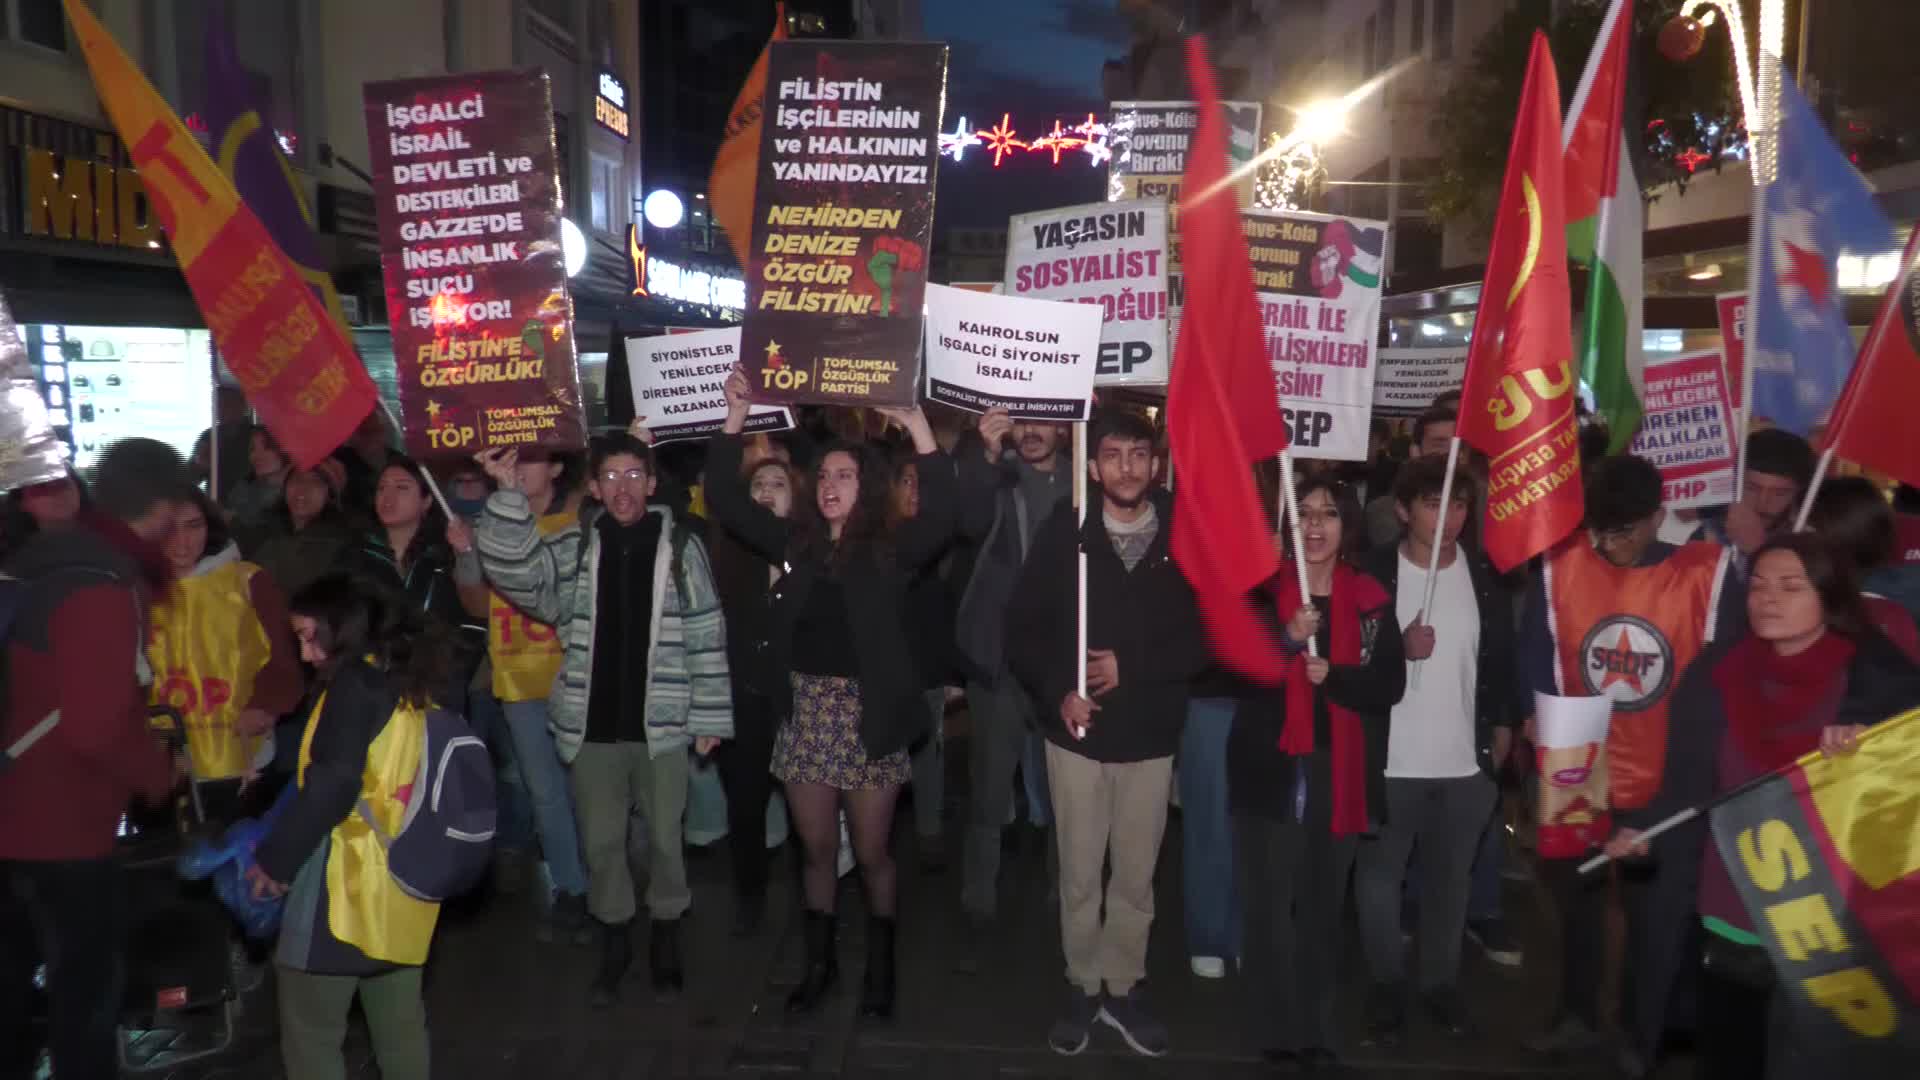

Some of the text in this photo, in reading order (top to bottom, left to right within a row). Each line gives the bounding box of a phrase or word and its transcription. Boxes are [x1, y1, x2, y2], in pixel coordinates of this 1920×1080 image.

[779, 77, 882, 101] FİLİSTİN
[386, 94, 484, 129] İŞGALCİ
[776, 104, 920, 130] İŞÇİLERİNİN
[390, 127, 472, 155] İSRAİL
[774, 135, 927, 157] ve HALKININ
[393, 152, 533, 184] DEVLETİ ve
[772, 161, 928, 184] YANINDAYIZ!
[396, 180, 520, 213] DESTEKÇİLERİ
[400, 212, 523, 241] GAZZE'DE
[767, 202, 902, 229] NEHİRDEN
[764, 231, 861, 256] DENİZE
[1033, 211, 1145, 250] YAŞASIN
[402, 241, 520, 271] İNSANLIK
[1249, 246, 1300, 265] ovunu
[763, 257, 853, 284] ÖZGÜR
[1016, 248, 1161, 293] SOSYALİST
[407, 274, 474, 299] SUÇU
[759, 286, 873, 315] FİLİSTİN!
[1317, 302, 1347, 332] İLE
[959, 321, 1060, 344] KAHROLSUN
[416, 334, 523, 364] FİLİSTİN'E
[651, 344, 734, 363] SİYONİSTLER
[939, 333, 1081, 365] İŞGALCİ SİYONİST
[1095, 341, 1152, 375] EP
[420, 358, 544, 388] ÖZGÜRLÜK!
[660, 362, 733, 380] YENİLECEK
[761, 364, 809, 390] TÖP
[821, 369, 891, 384] ÖZGÜRLÜK
[822, 357, 899, 372] TOPLUMSAL
[976, 361, 1033, 381] İSRAİL!
[642, 384, 697, 400] DİRENEN
[821, 380, 870, 395] PARTİSİ
[936, 386, 977, 403] SOSYALİST
[485, 404, 563, 420] TOPLUMSAL
[663, 398, 727, 415] KAZANAC
[426, 423, 475, 449] TÖP
[488, 417, 556, 433] ÖZGÜRLÜK
[489, 430, 538, 446] PARTİSİ
[160, 666, 231, 716] ÖP
[1735, 818, 1897, 1037] SEP
